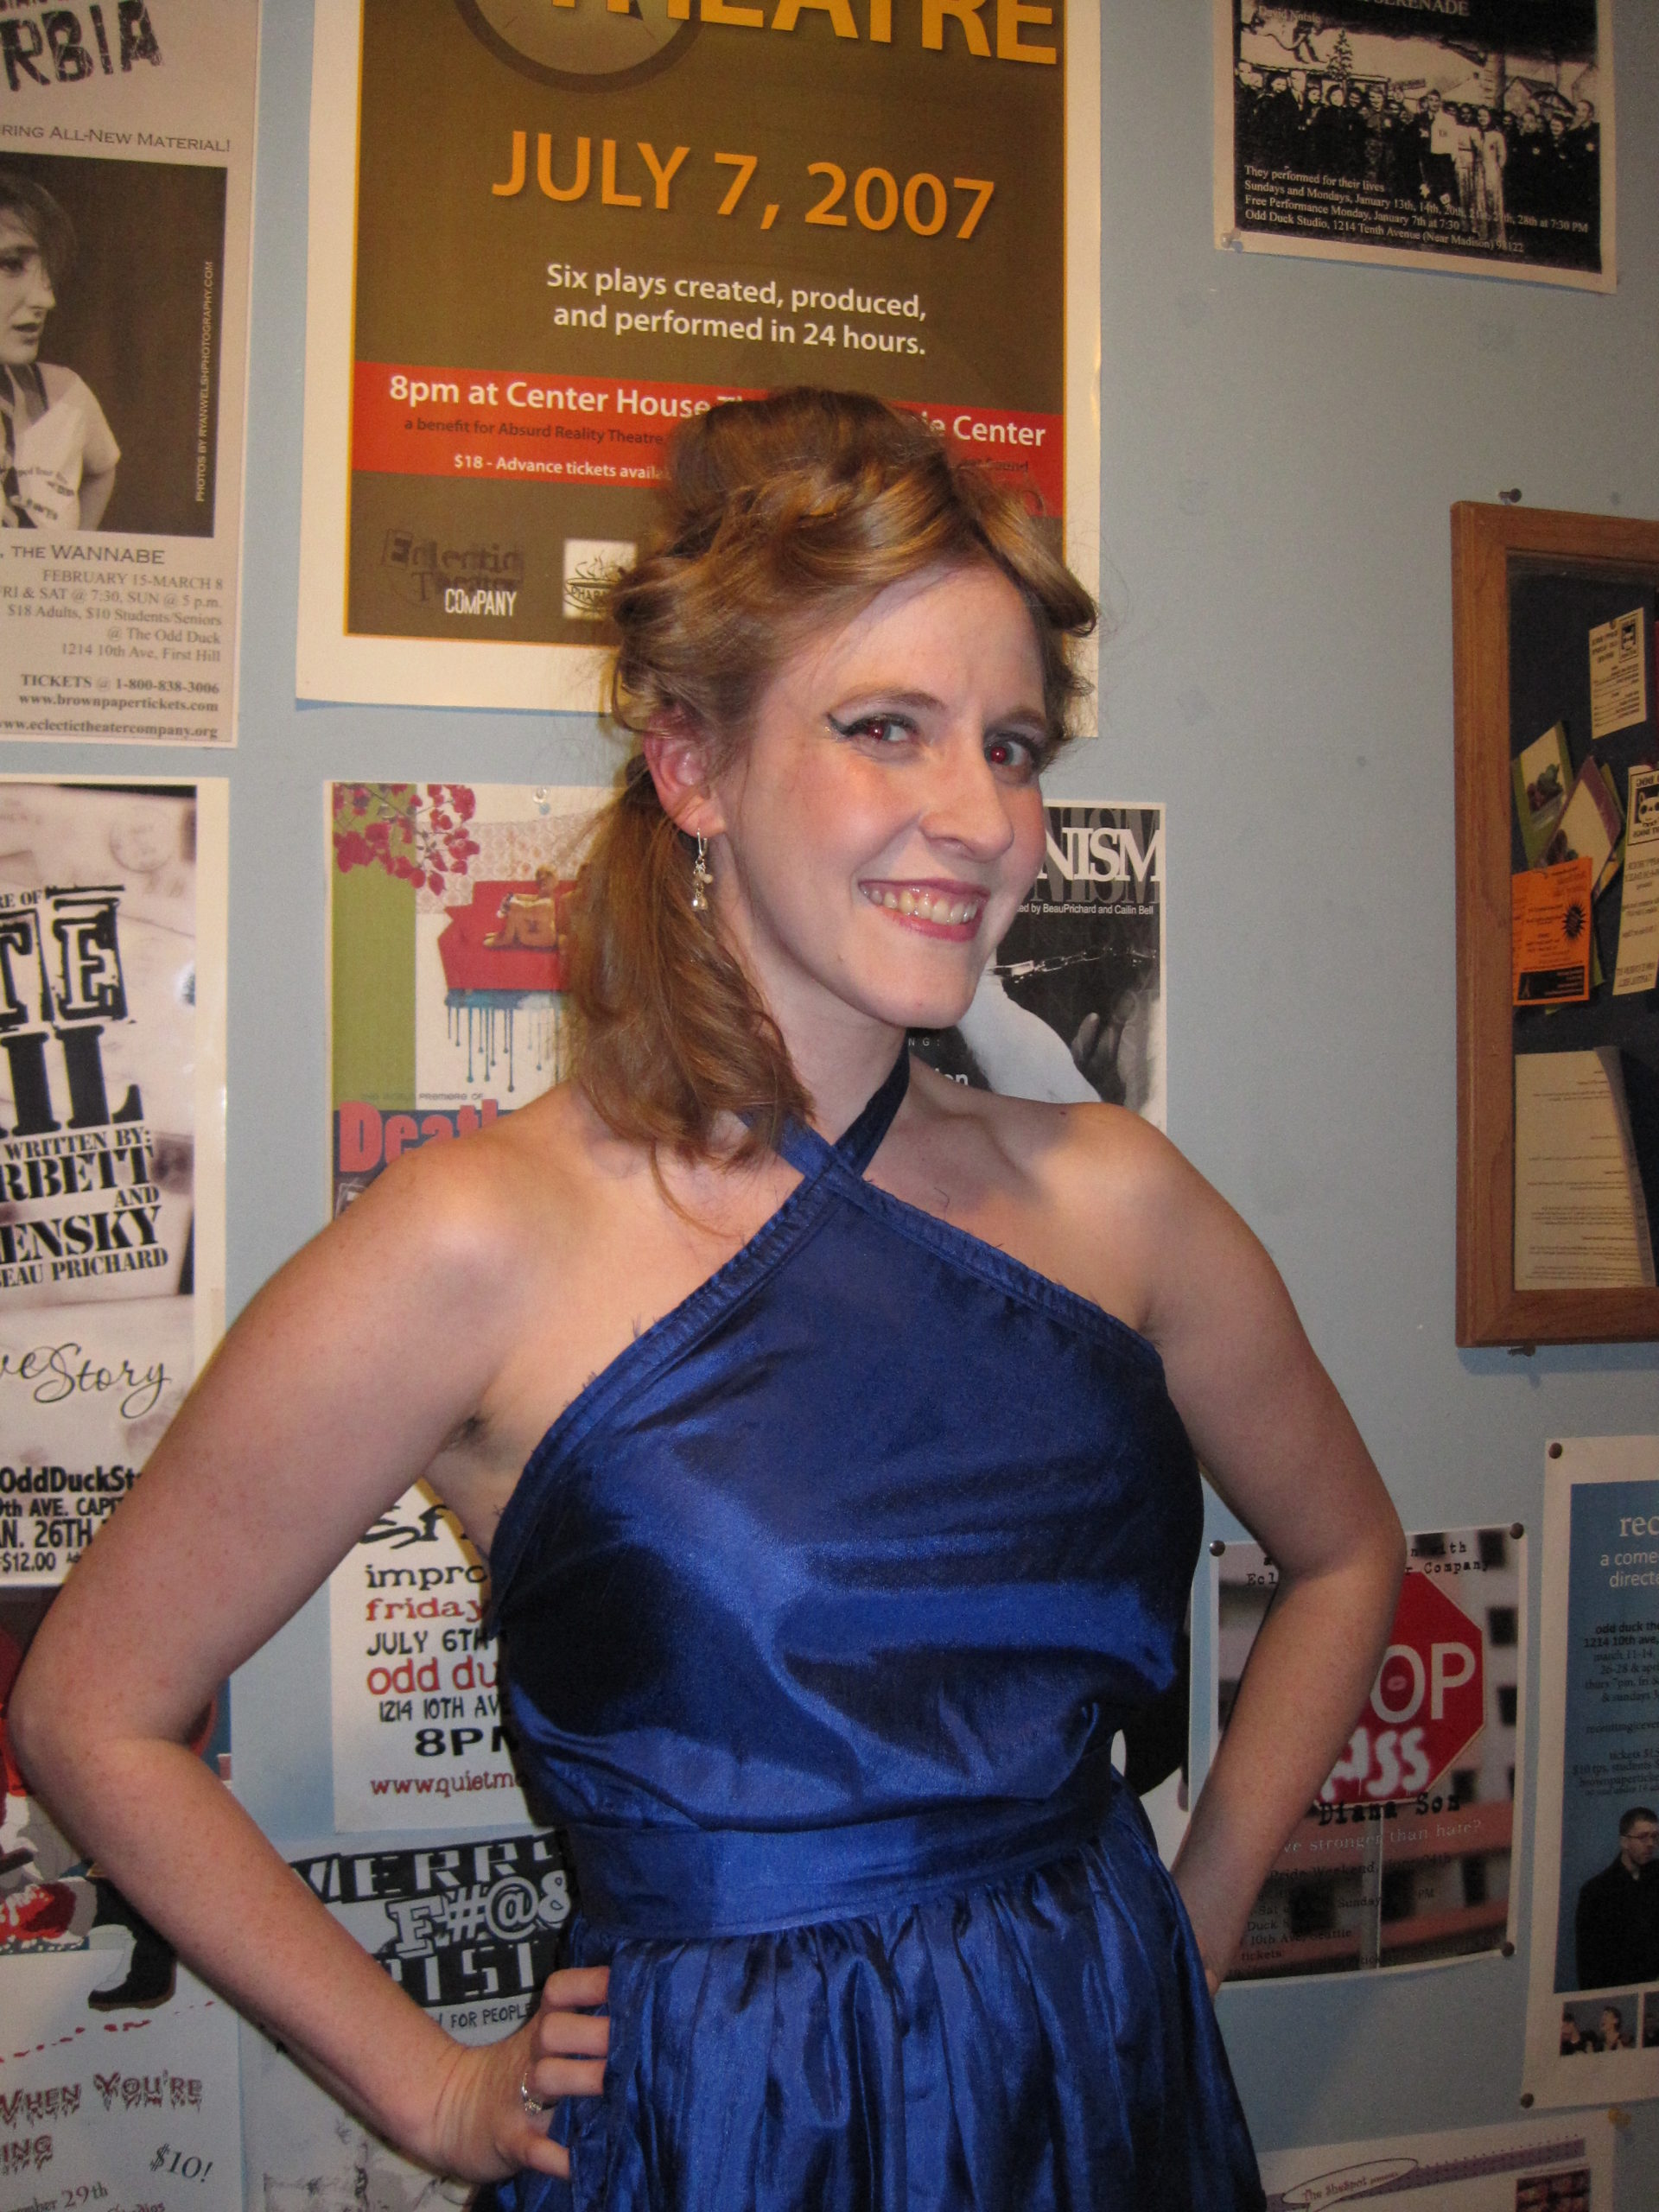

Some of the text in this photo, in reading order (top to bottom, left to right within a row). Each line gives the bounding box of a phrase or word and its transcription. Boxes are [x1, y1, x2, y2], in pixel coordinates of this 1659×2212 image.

[492, 130, 995, 239] JULY 7, 2007
[1244, 165, 1384, 192] They performed for their lives
[1245, 180, 1285, 195] Sundays
[1287, 187, 1304, 197] and
[1307, 188, 1353, 204] Mondays,
[1355, 194, 1390, 209] January
[1540, 218, 1548, 228] at
[1550, 219, 1569, 230] 7:30
[1572, 221, 1588, 233] PM
[1245, 194, 1459, 230] Free Performance Monday, January 7th at 7:30
[1245, 210, 1266, 221] Odd
[1269, 213, 1294, 224] Duck
[1333, 219, 1356, 232] 1214
[1358, 222, 1383, 235] Tenth
[1386, 227, 1420, 240] Avenue
[547, 264, 926, 322] Six plays created, produced,
[554, 305, 925, 355] and performed in 24 hours.
[390, 375, 460, 408] 8pm
[468, 385, 499, 405] at
[506, 382, 608, 412] Center
[617, 389, 713, 418] House
[404, 419, 664, 445] a benefit for Absurd Reality Theatre
[953, 415, 1046, 447] Center
[454, 454, 484, 470] $18
[496, 457, 563, 474] Advance
[566, 461, 616, 478] tickets
[11, 544, 165, 564] THE WANNABE
[43, 569, 223, 590] FEBRUARY 15-MARCH 8
[23, 587, 35, 599] &
[40, 588, 67, 600] SAT
[72, 589, 85, 603] @
[127, 591, 159, 604] SUN
[164, 594, 176, 608] @
[182, 594, 190, 607] 5
[8, 604, 111, 620] $18 Adults, $10
[107, 626, 221, 644] @ The Odd Duck
[62, 643, 92, 655] 1214
[98, 644, 125, 658] 10th
[162, 647, 191, 660] First
[196, 649, 220, 662] Hill
[21, 673, 92, 688] TICKETS
[116, 677, 219, 695] 1-800-838-3006
[19, 692, 219, 713] www.brownpapertickets.com
[20, 889, 42, 906] OF
[1032, 904, 1041, 915] by
[1098, 905, 1113, 914] and
[1139, 906, 1154, 916] Bell
[4, 1126, 151, 1161] WRITTEN BY:
[340, 1099, 498, 1173] Deat
[114, 1185, 160, 1208] AND
[51, 1247, 168, 1281] PRICHARD
[0, 1465, 142, 1494] OddDuckSt
[29, 1497, 68, 1517] AVE.
[35, 1518, 93, 1548] 26TH
[3, 1552, 56, 1573] $12.00
[1425, 1560, 1488, 1577] Company
[1600, 1554, 1609, 1567] a
[365, 1597, 484, 1622] friday
[1595, 1622, 1643, 1635] odd duck
[367, 1630, 428, 1656] JULY
[367, 1656, 440, 1695] odd
[379, 1700, 412, 1722] 1214
[424, 1697, 464, 1719] 10TH
[1415, 1792, 1460, 1815] Son
[1309, 1834, 1382, 1852] stronger
[1389, 1827, 1428, 1843] than
[1436, 1819, 1482, 1838] hate?
[451, 2012, 478, 2029] FOR
[149, 2143, 213, 2183] $10!
[61, 2181, 109, 2209] 29th
